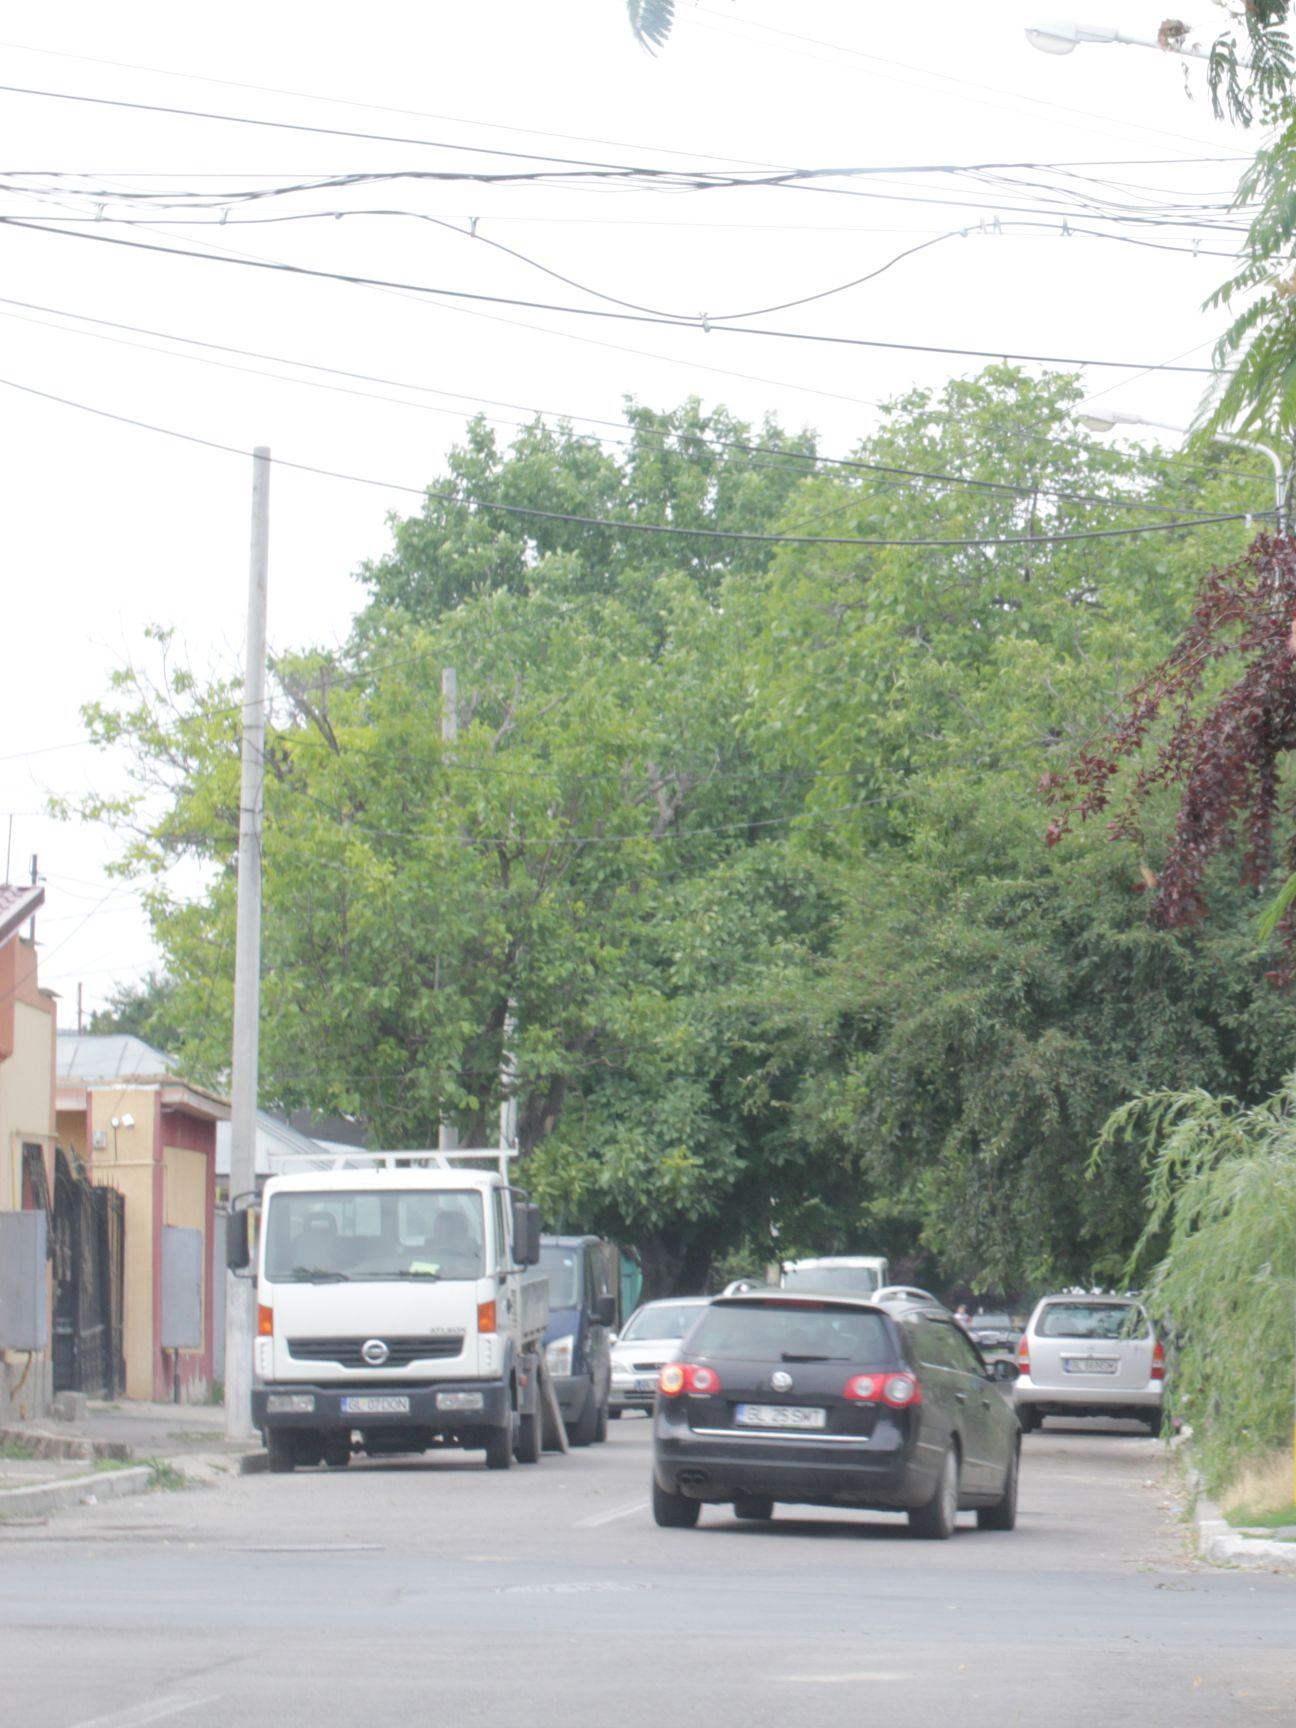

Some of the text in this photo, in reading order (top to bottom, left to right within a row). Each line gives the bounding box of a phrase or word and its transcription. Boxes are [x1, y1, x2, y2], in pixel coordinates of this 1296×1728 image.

[348, 1398, 361, 1410] GL
[747, 1406, 766, 1421] GL
[772, 1407, 789, 1423] 25
